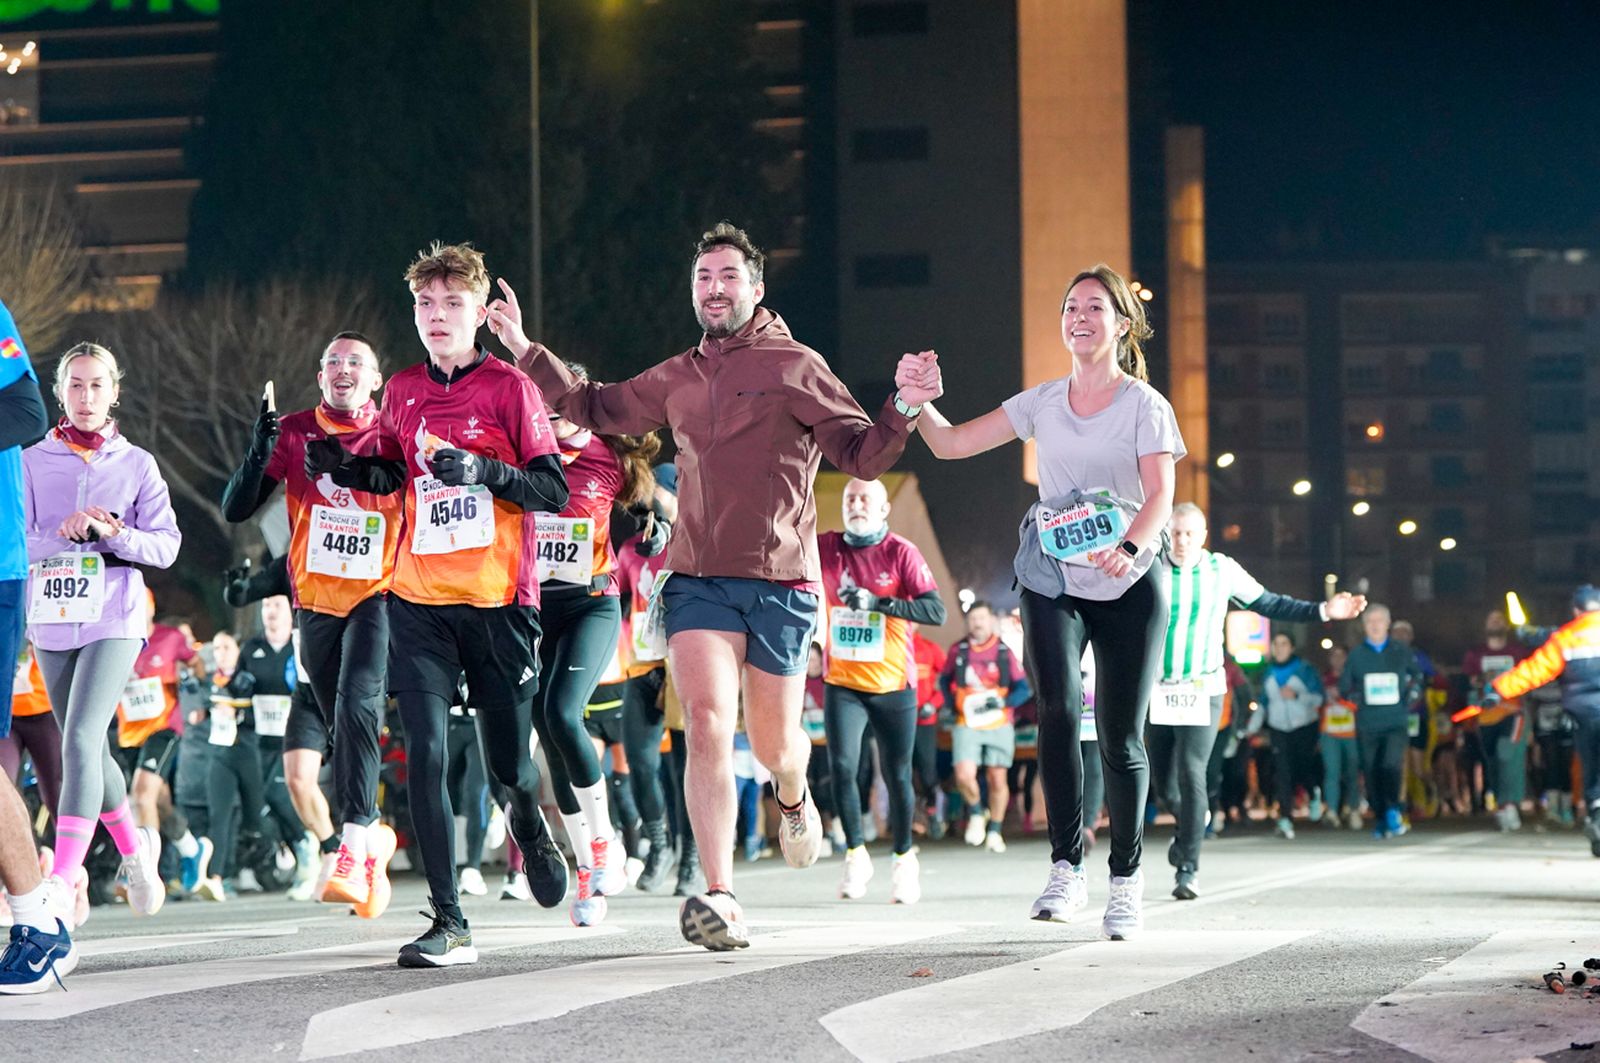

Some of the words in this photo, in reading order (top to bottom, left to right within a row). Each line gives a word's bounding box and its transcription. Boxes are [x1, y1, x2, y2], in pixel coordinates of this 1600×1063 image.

[331, 489, 350, 508] 43
[424, 493, 435, 503] SAN
[430, 495, 477, 527] 4546
[319, 521, 333, 530] SAN
[329, 516, 350, 525] NOCHE
[351, 518, 360, 526] DE
[557, 524, 565, 532] DE
[1044, 517, 1060, 530] SAN
[1053, 513, 1112, 550] 8599
[322, 532, 371, 556] 4483
[65, 559, 74, 567] DE
[43, 577, 89, 599] 4992
[839, 626, 873, 643] 8978
